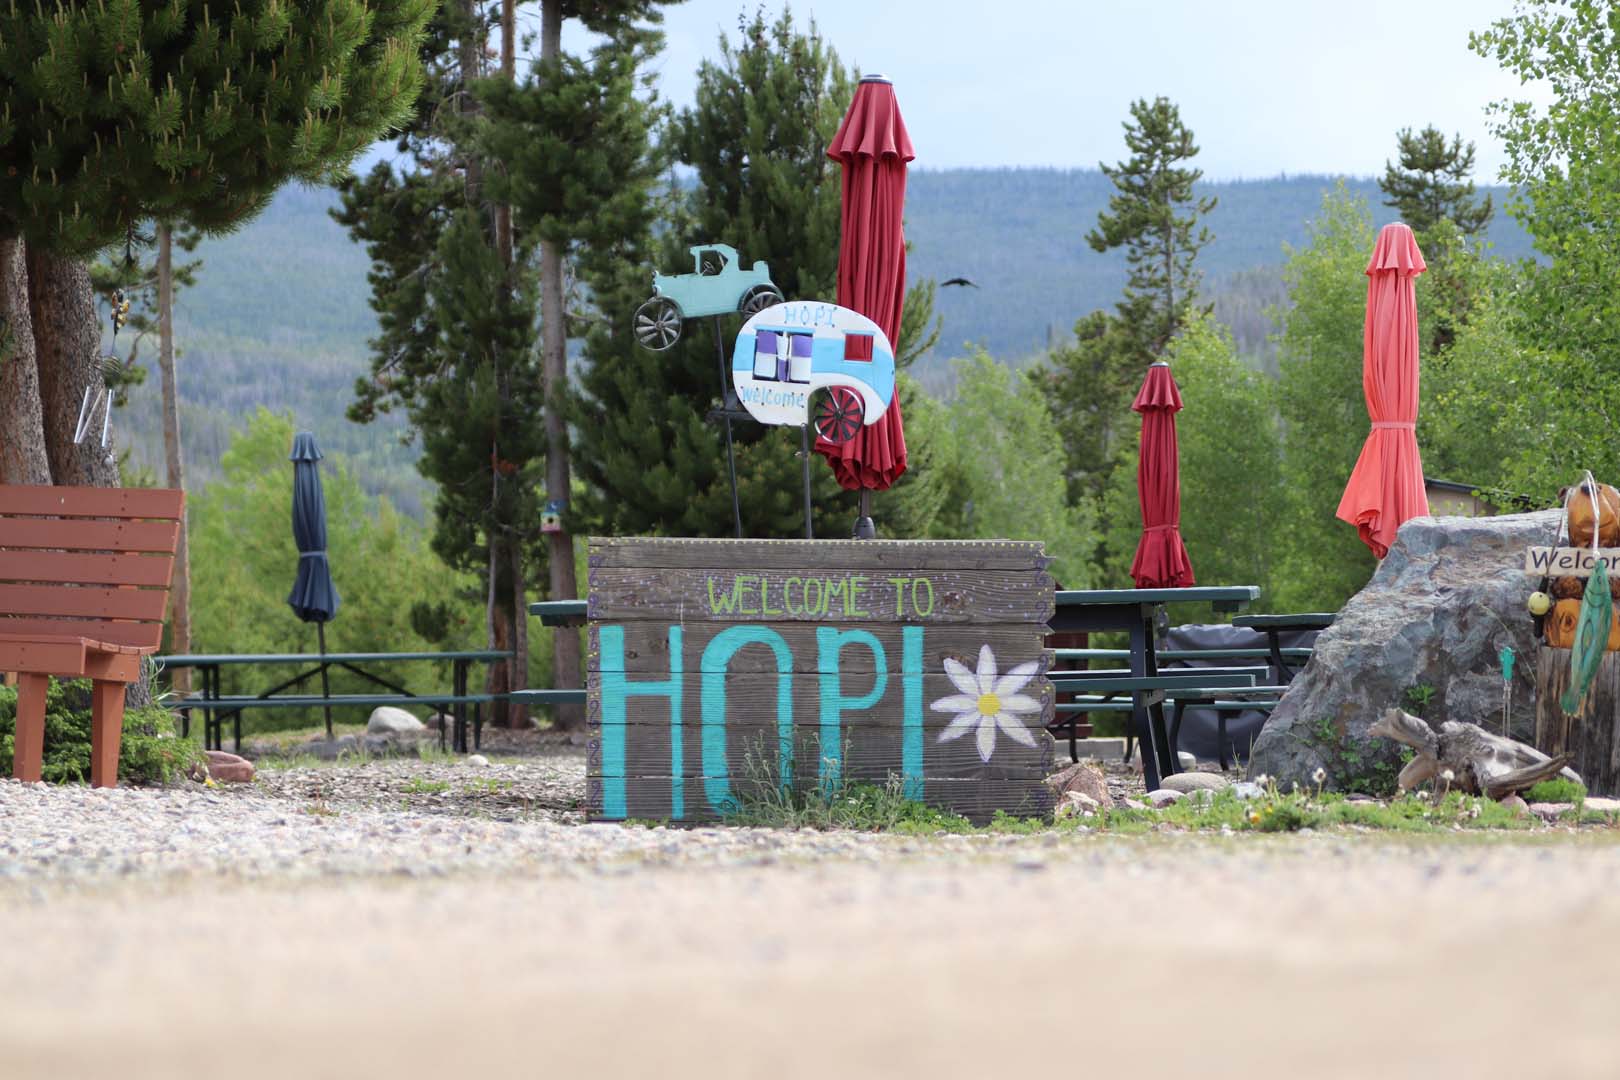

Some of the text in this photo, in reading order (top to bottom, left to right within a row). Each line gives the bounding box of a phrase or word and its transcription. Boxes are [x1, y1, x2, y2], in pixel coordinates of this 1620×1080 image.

[784, 305, 835, 327] HOPI
[706, 575, 935, 617] WELCOME TO
[600, 625, 925, 819] HOPI
